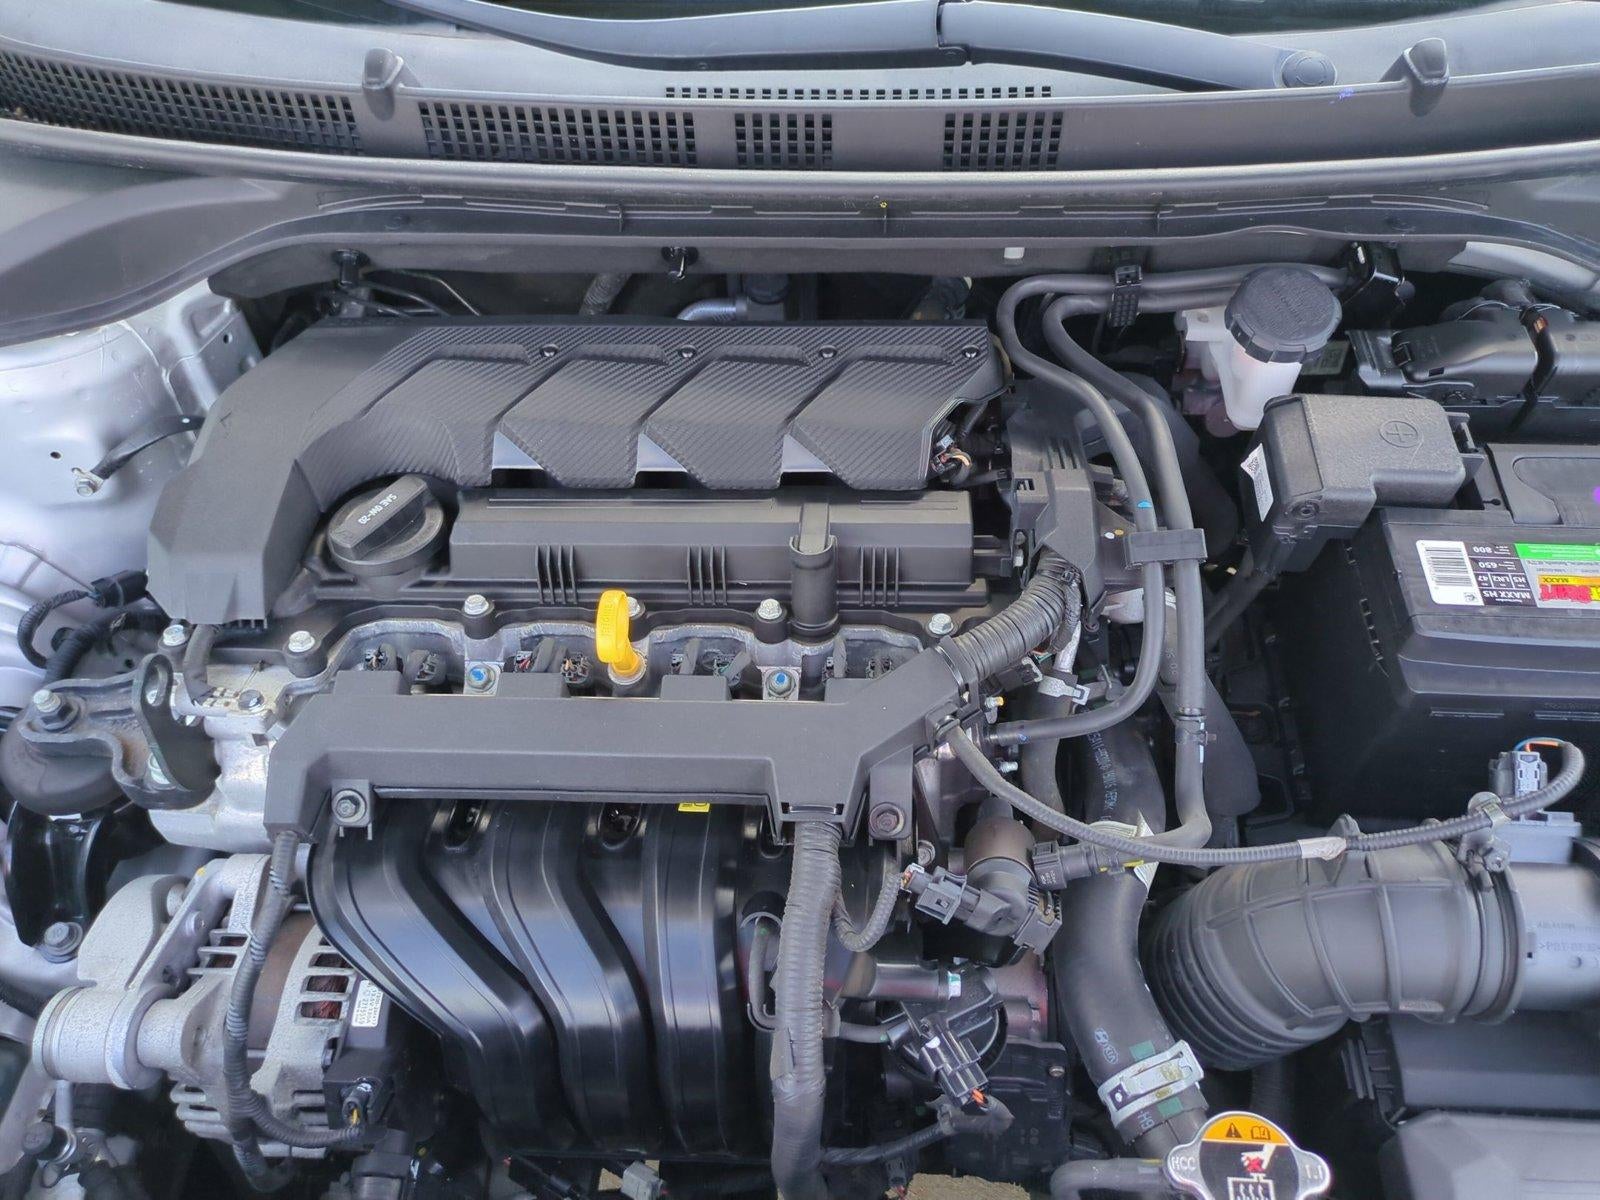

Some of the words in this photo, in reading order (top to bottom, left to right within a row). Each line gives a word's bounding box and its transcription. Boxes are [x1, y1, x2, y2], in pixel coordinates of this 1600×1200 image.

[379, 493, 397, 507] SAE
[358, 504, 383, 524] 0W-20
[1478, 561, 1497, 569] 650
[1499, 590, 1531, 598] MAXX
[1171, 1156, 1196, 1171] HCC
